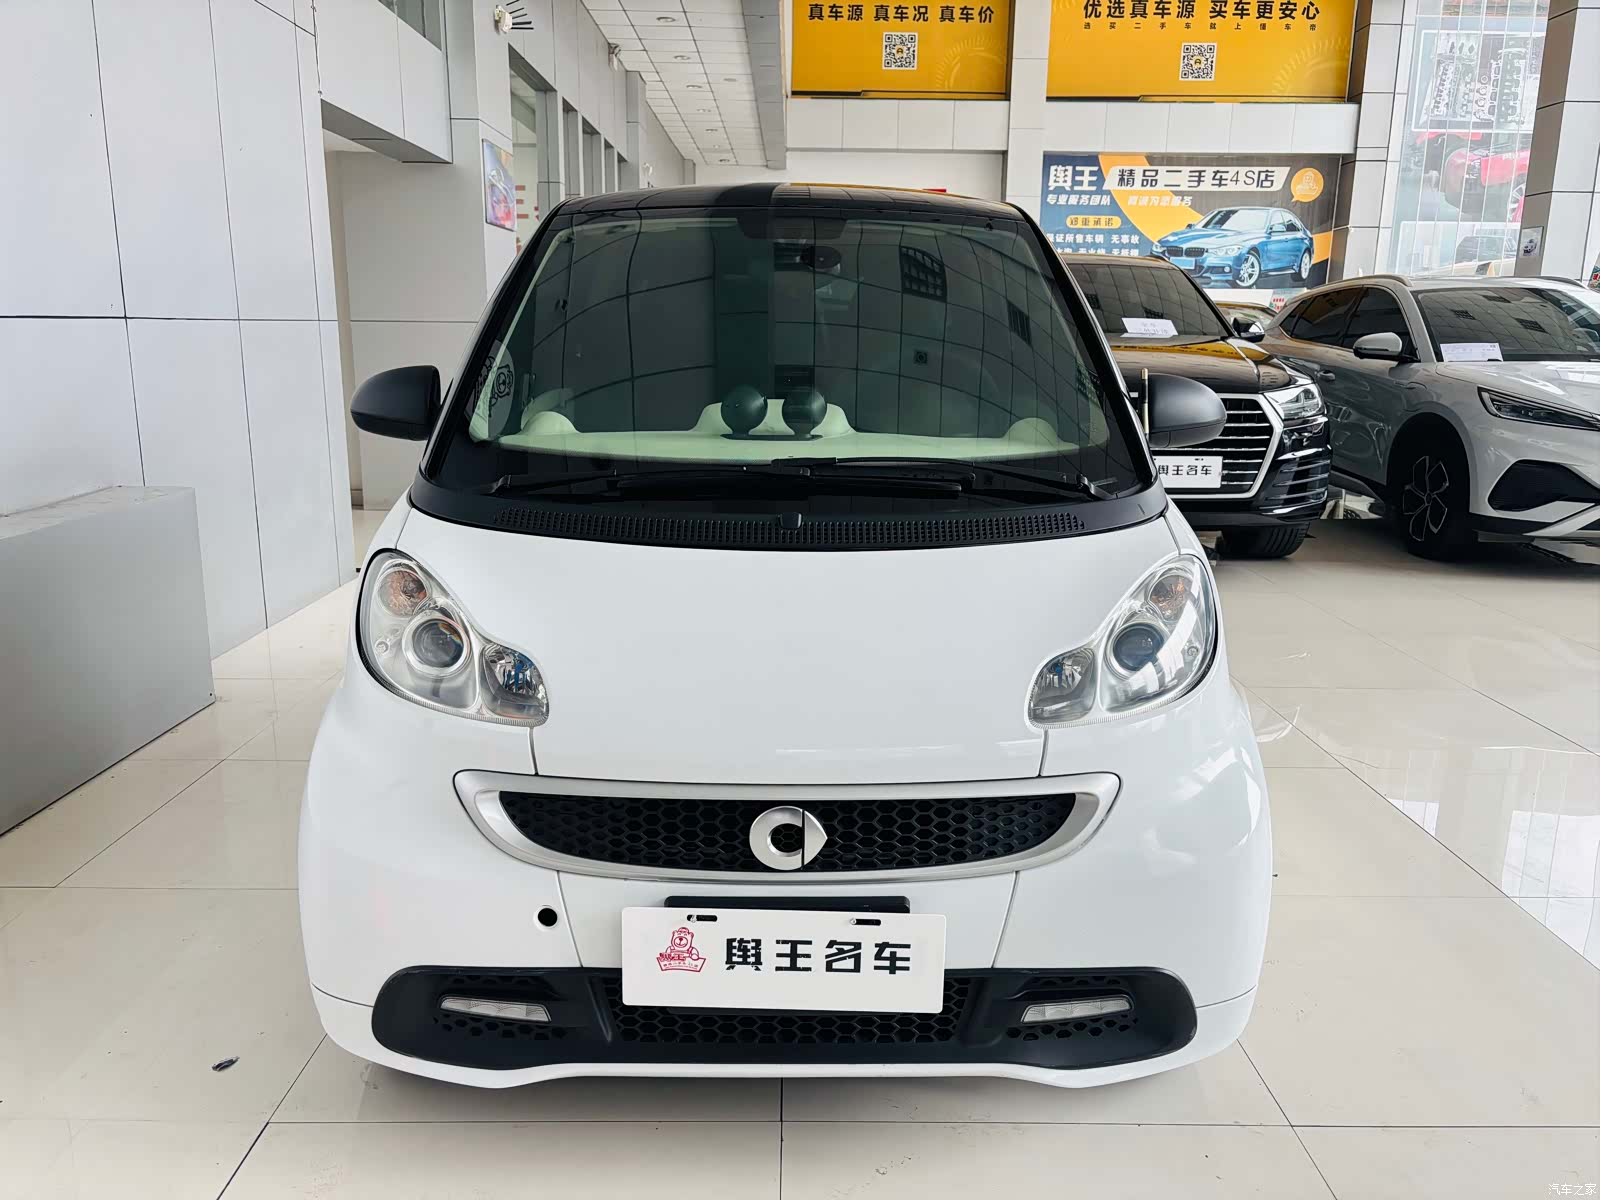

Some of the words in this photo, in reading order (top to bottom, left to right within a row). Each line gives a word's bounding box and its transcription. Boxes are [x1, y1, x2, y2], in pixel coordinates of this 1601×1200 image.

[808, 4, 863, 21] 真车源
[874, 5, 929, 22] 真车况
[939, 6, 994, 23] 真车价
[1084, 0, 1195, 19] 优选真车源
[1209, 0, 1320, 20] 买车更安心
[1117, 168, 1275, 188] 精品二手车4S店
[1046, 194, 1111, 206] 专业服务团队
[725, 937, 912, 975] 舆王名车
